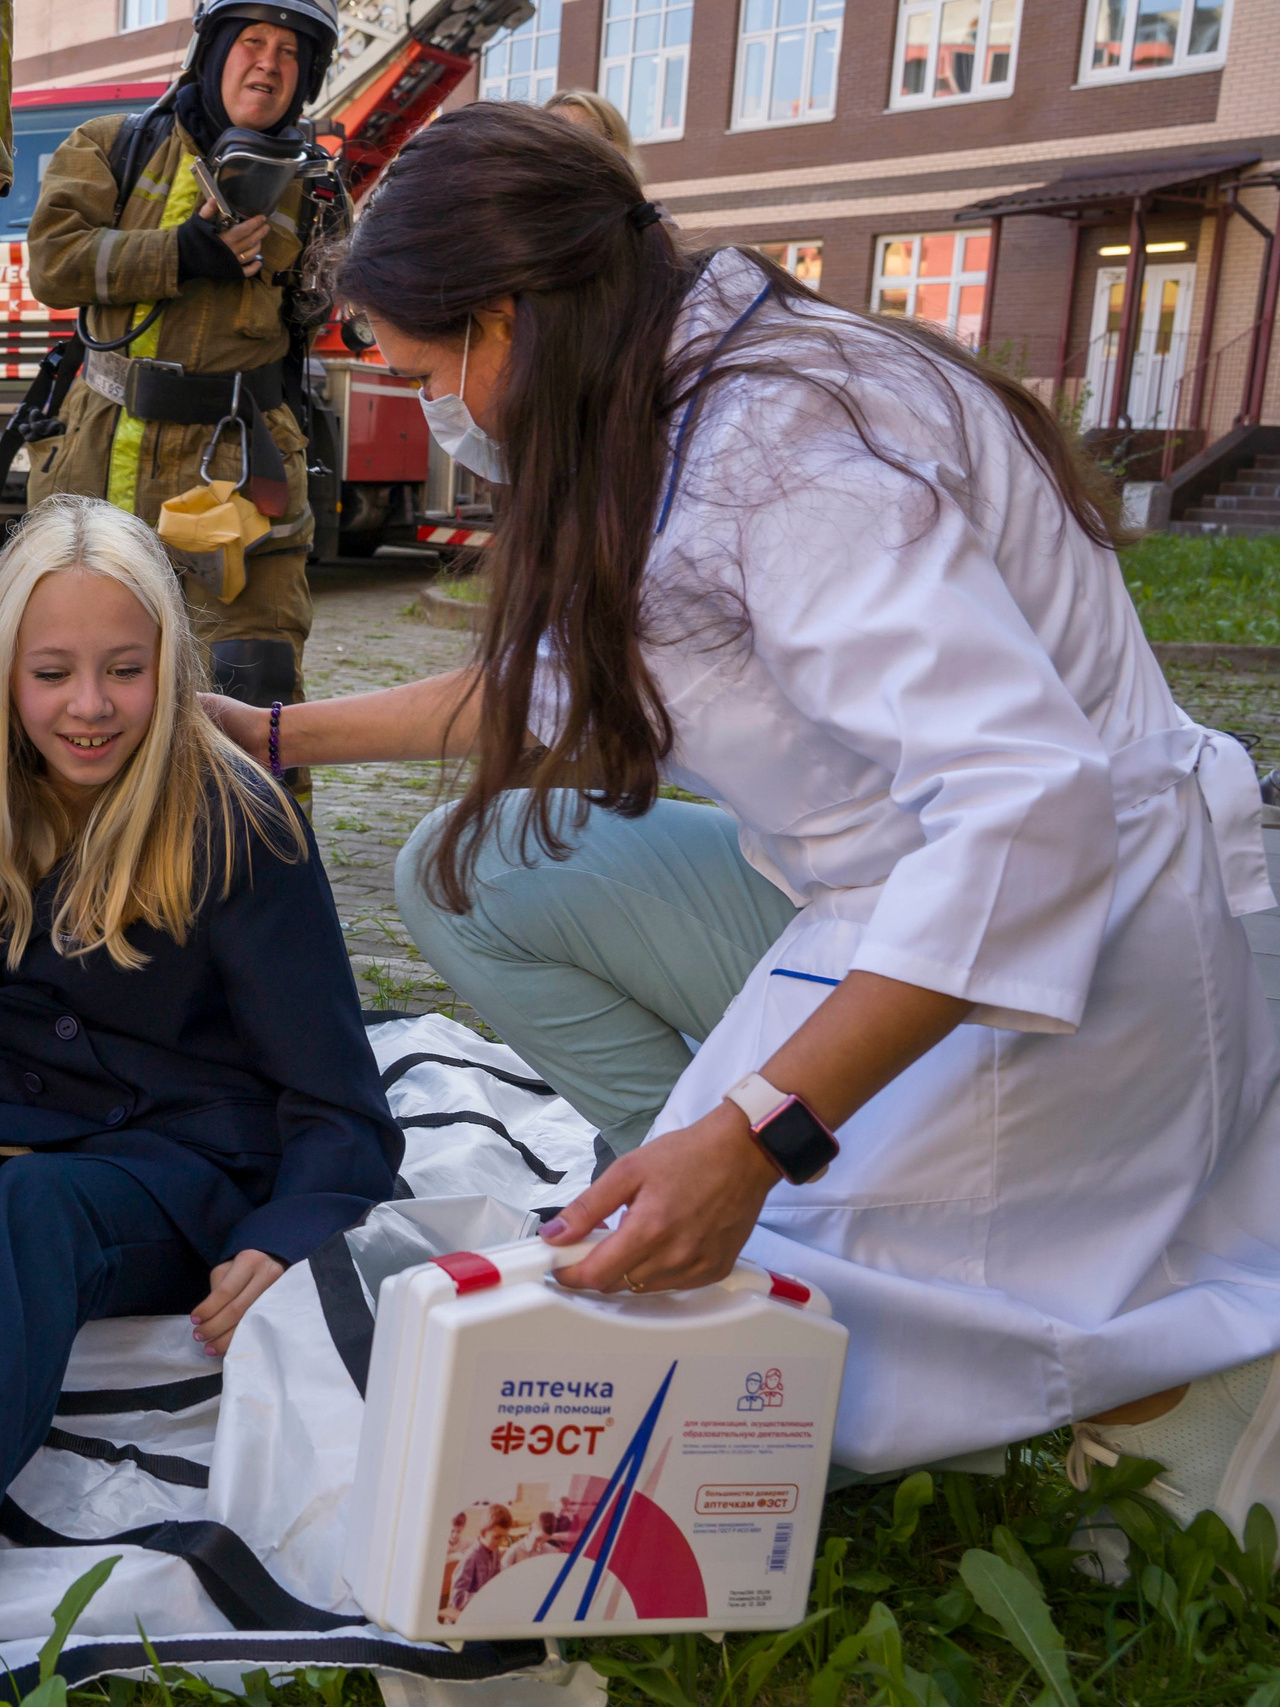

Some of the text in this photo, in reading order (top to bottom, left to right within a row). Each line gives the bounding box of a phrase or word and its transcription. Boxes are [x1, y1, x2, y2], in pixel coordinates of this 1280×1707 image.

[500, 1379, 614, 1398] аптечка
[497, 1401, 612, 1416] первой помощи
[703, 1500, 755, 1509] аптечкам
